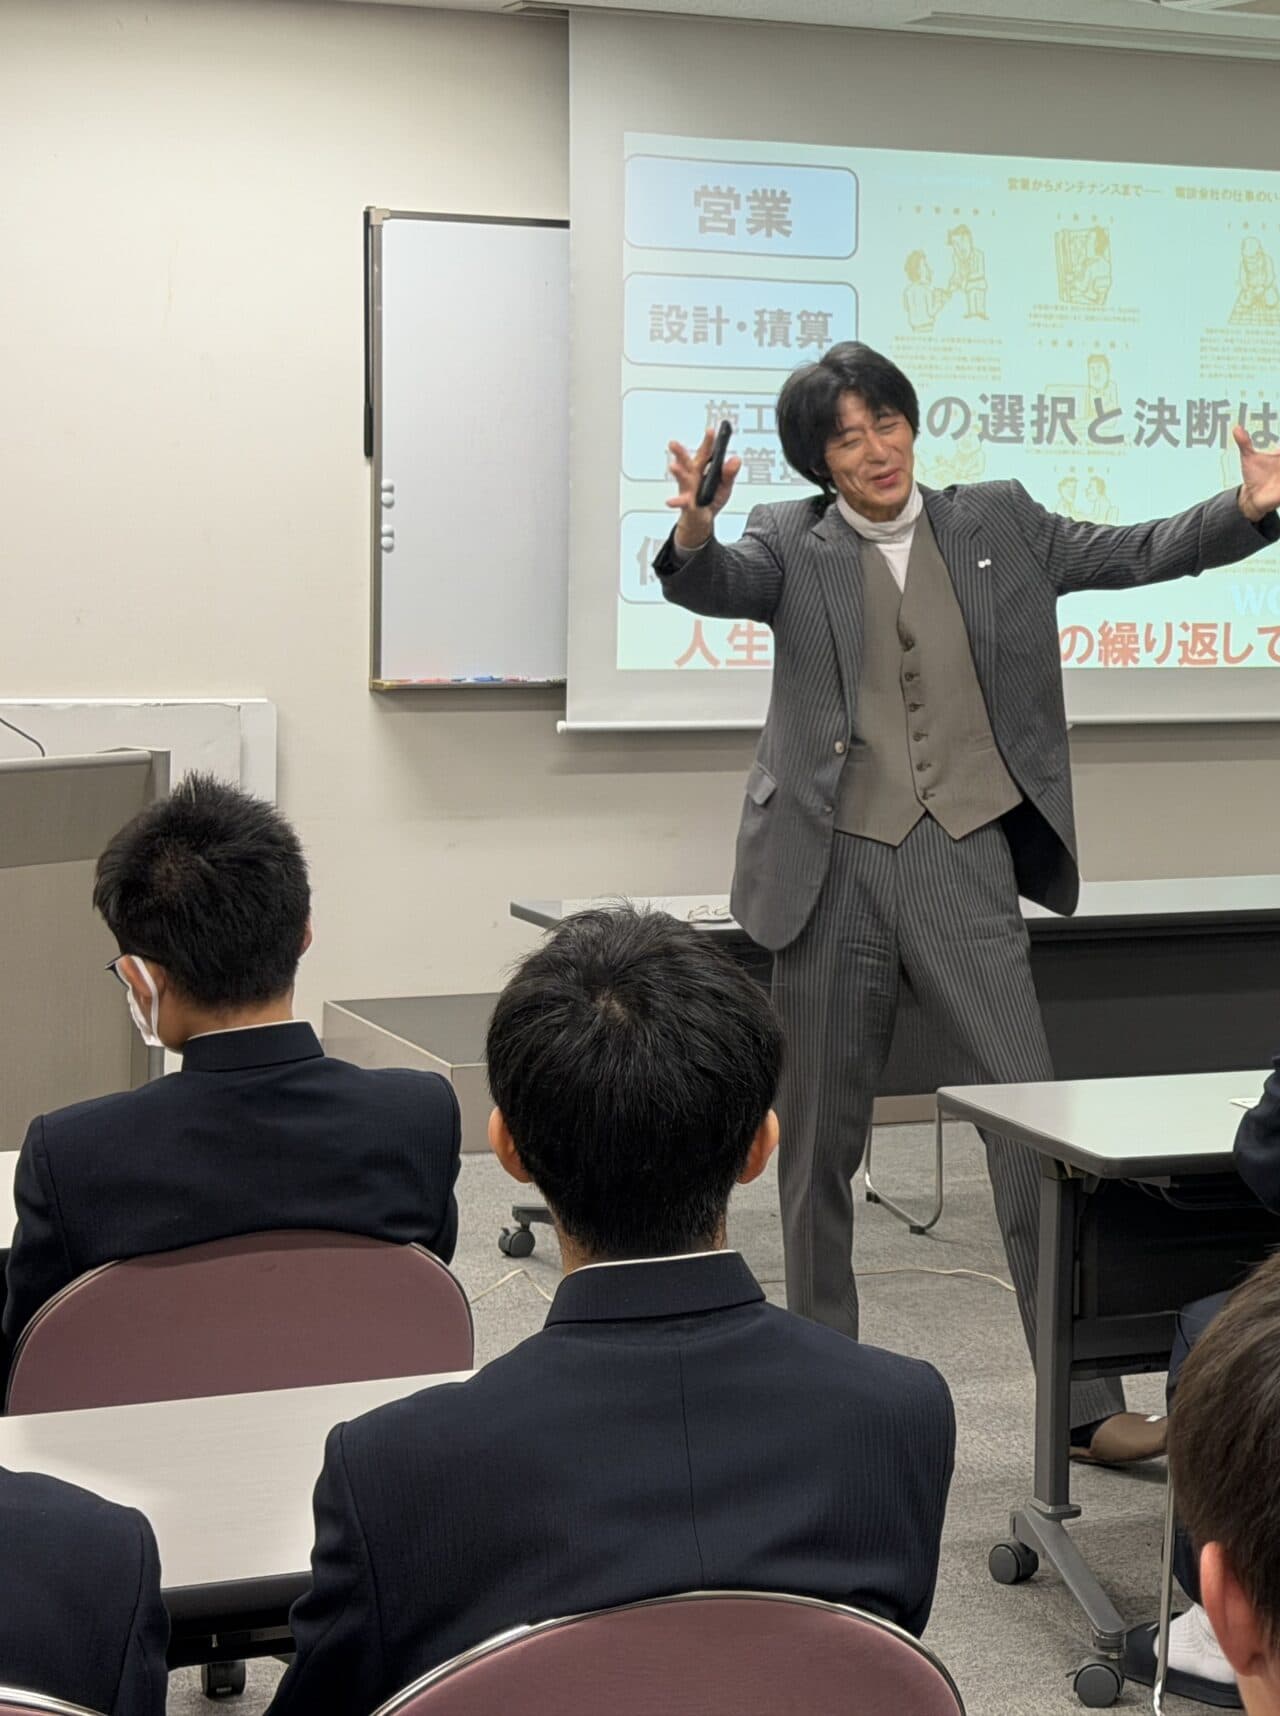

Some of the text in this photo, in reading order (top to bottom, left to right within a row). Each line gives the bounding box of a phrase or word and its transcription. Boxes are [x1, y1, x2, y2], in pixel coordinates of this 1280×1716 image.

[694, 185, 793, 238] 営業
[649, 304, 834, 349] 設計・積算
[674, 618, 771, 668] 人生
